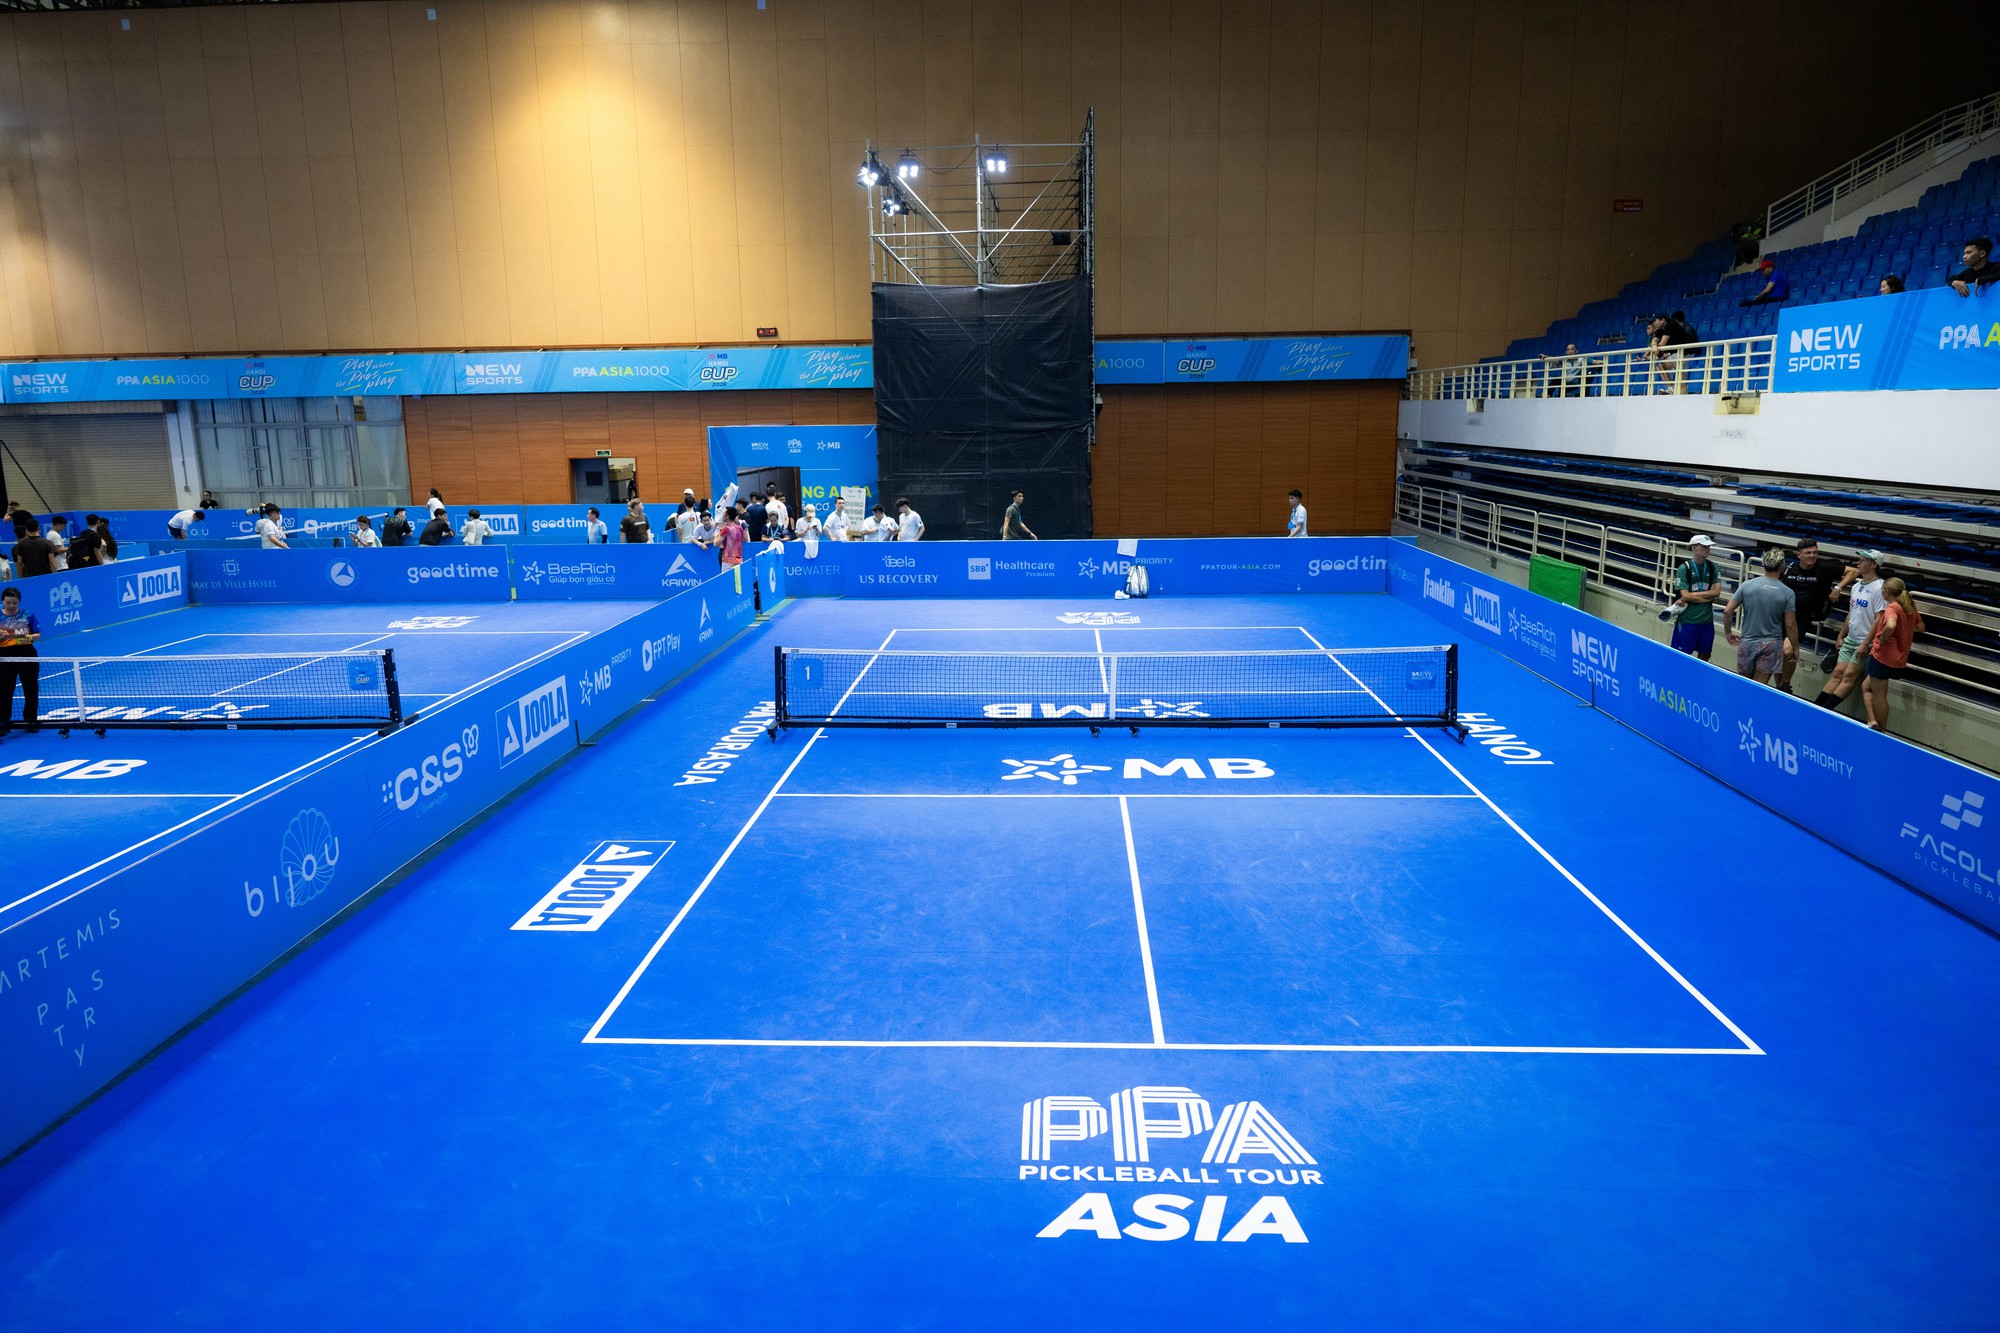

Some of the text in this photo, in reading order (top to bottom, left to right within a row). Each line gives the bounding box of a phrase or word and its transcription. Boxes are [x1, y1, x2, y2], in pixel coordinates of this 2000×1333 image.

[1790, 324, 1863, 353] NEW
[1939, 324, 1981, 350] PPA
[465, 364, 522, 377] NEW
[1094, 358, 1144, 369] A1000
[1178, 359, 1216, 372] CUP
[1788, 353, 1861, 372] SPORTS
[13, 374, 66, 386] NEW
[116, 375, 140, 385] PPA
[572, 366, 598, 377] PPA
[701, 367, 738, 381] CUP
[239, 375, 275, 388] CUP
[466, 376, 523, 385] SPORTS
[14, 385, 69, 394] SPORTS
[787, 438, 803, 447] PPA
[827, 441, 841, 449] MB
[483, 517, 517, 532] OOLA
[532, 517, 587, 532] goodtim
[547, 562, 616, 576] BeeRich
[970, 564, 987, 573] SBB
[995, 560, 1055, 571] Healthcare
[1102, 561, 1129, 575] MB
[1135, 557, 1174, 565] PRIORITY
[1308, 555, 1387, 577] goodtim
[783, 564, 841, 576] ueWATER
[141, 571, 179, 598] JOOLA
[210, 581, 222, 589] DE
[249, 580, 278, 588] HOTEL
[548, 574, 616, 585] Giúp bạn giàu có
[859, 574, 939, 585] US RECOVERY
[50, 582, 82, 608] PPA
[1856, 598, 1868, 608] MB
[54, 610, 80, 626] ASIA
[1474, 594, 1500, 631] JOOLA
[1520, 613, 1556, 645] BeeRich
[652, 633, 681, 661] FPT Play
[1571, 628, 1618, 673] NEW
[611, 647, 632, 667] PRIORITY
[594, 664, 612, 695] MB
[804, 665, 811, 681] 1
[1572, 658, 1620, 697] SPORTS
[1639, 675, 1658, 702] PPA
[523, 686, 567, 740] JOOLA
[1764, 732, 1799, 776] MB
[1802, 744, 1853, 779] PRIORITY
[0, 759, 148, 780] MB
[395, 742, 463, 811] C&S
[1123, 758, 1275, 779] MB
[1900, 822, 2000, 885] FACOL
[1914, 851, 2000, 904] PICKLEBA
[528, 867, 636, 928] JOOLA
[1021, 1085, 1318, 1165] PPA
[1019, 1165, 1325, 1185] PICKLEBALL TOUR
[1035, 1192, 1310, 1243] ASIA
